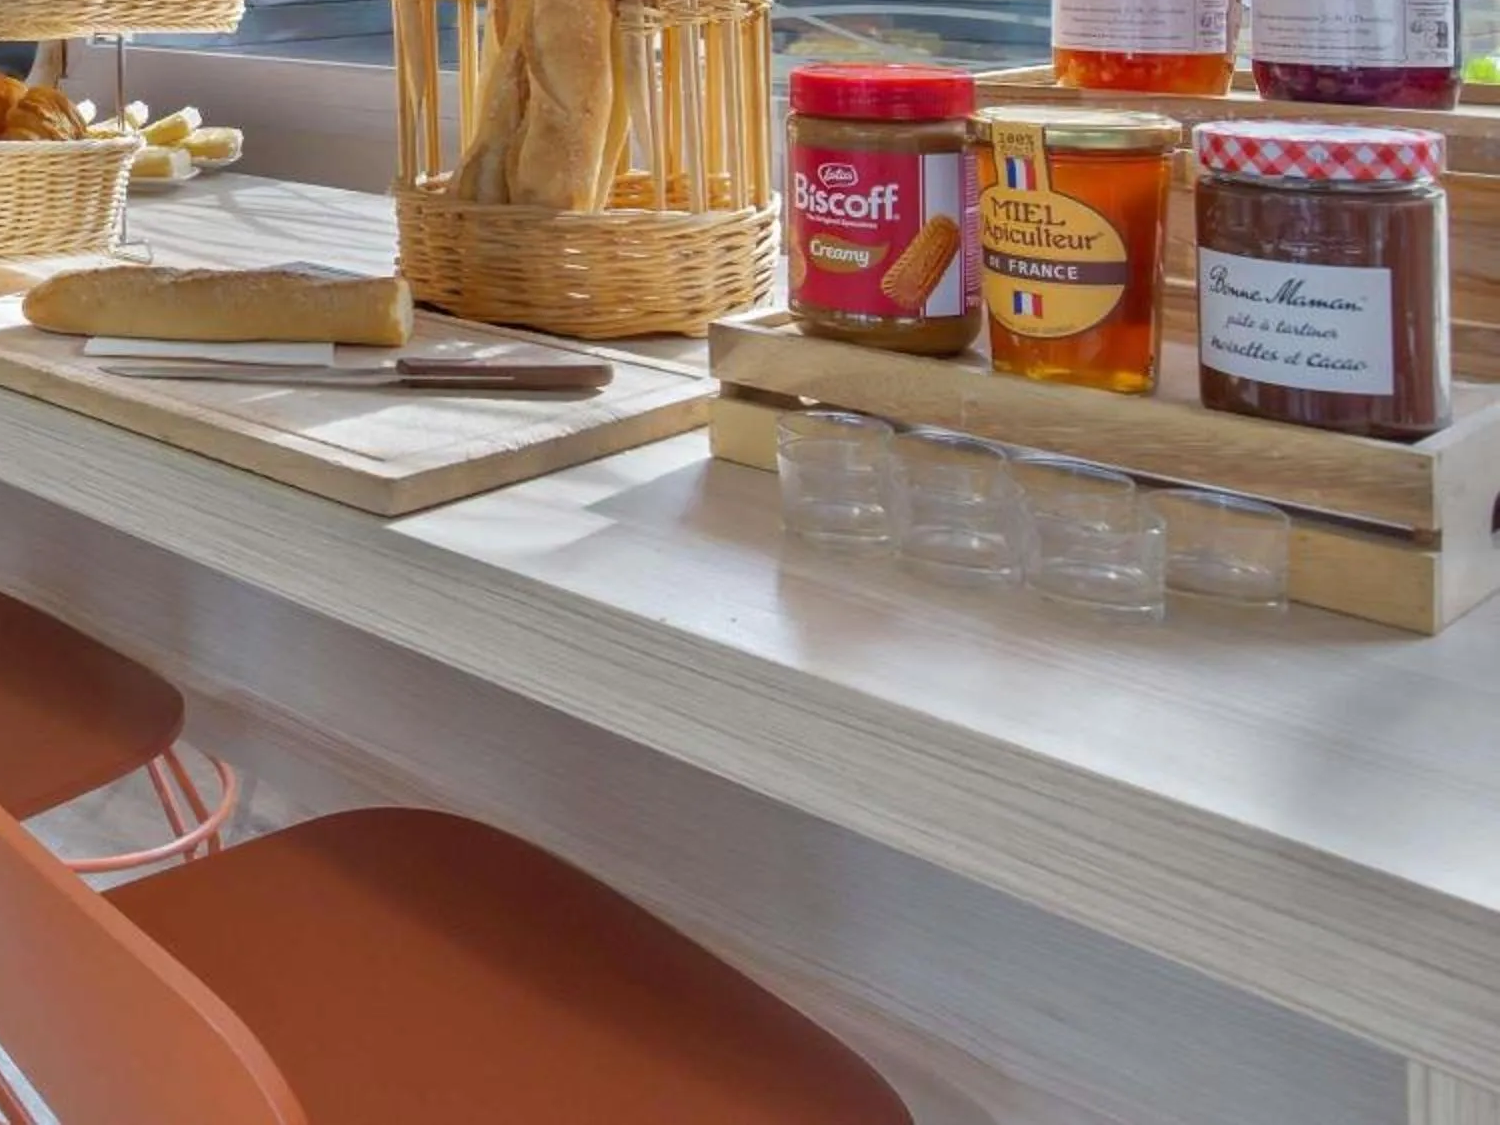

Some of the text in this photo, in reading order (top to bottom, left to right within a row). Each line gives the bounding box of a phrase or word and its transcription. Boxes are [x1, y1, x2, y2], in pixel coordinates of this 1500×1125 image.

[795, 171, 899, 221] Biscoff
[990, 196, 1067, 227] MIEL
[809, 238, 869, 268] Creamy
[1008, 258, 1078, 281] FRANCE
[1208, 262, 1363, 313] Bonne Maman
[1275, 320, 1339, 340] tartiner
[1210, 334, 1279, 362] noisettes
